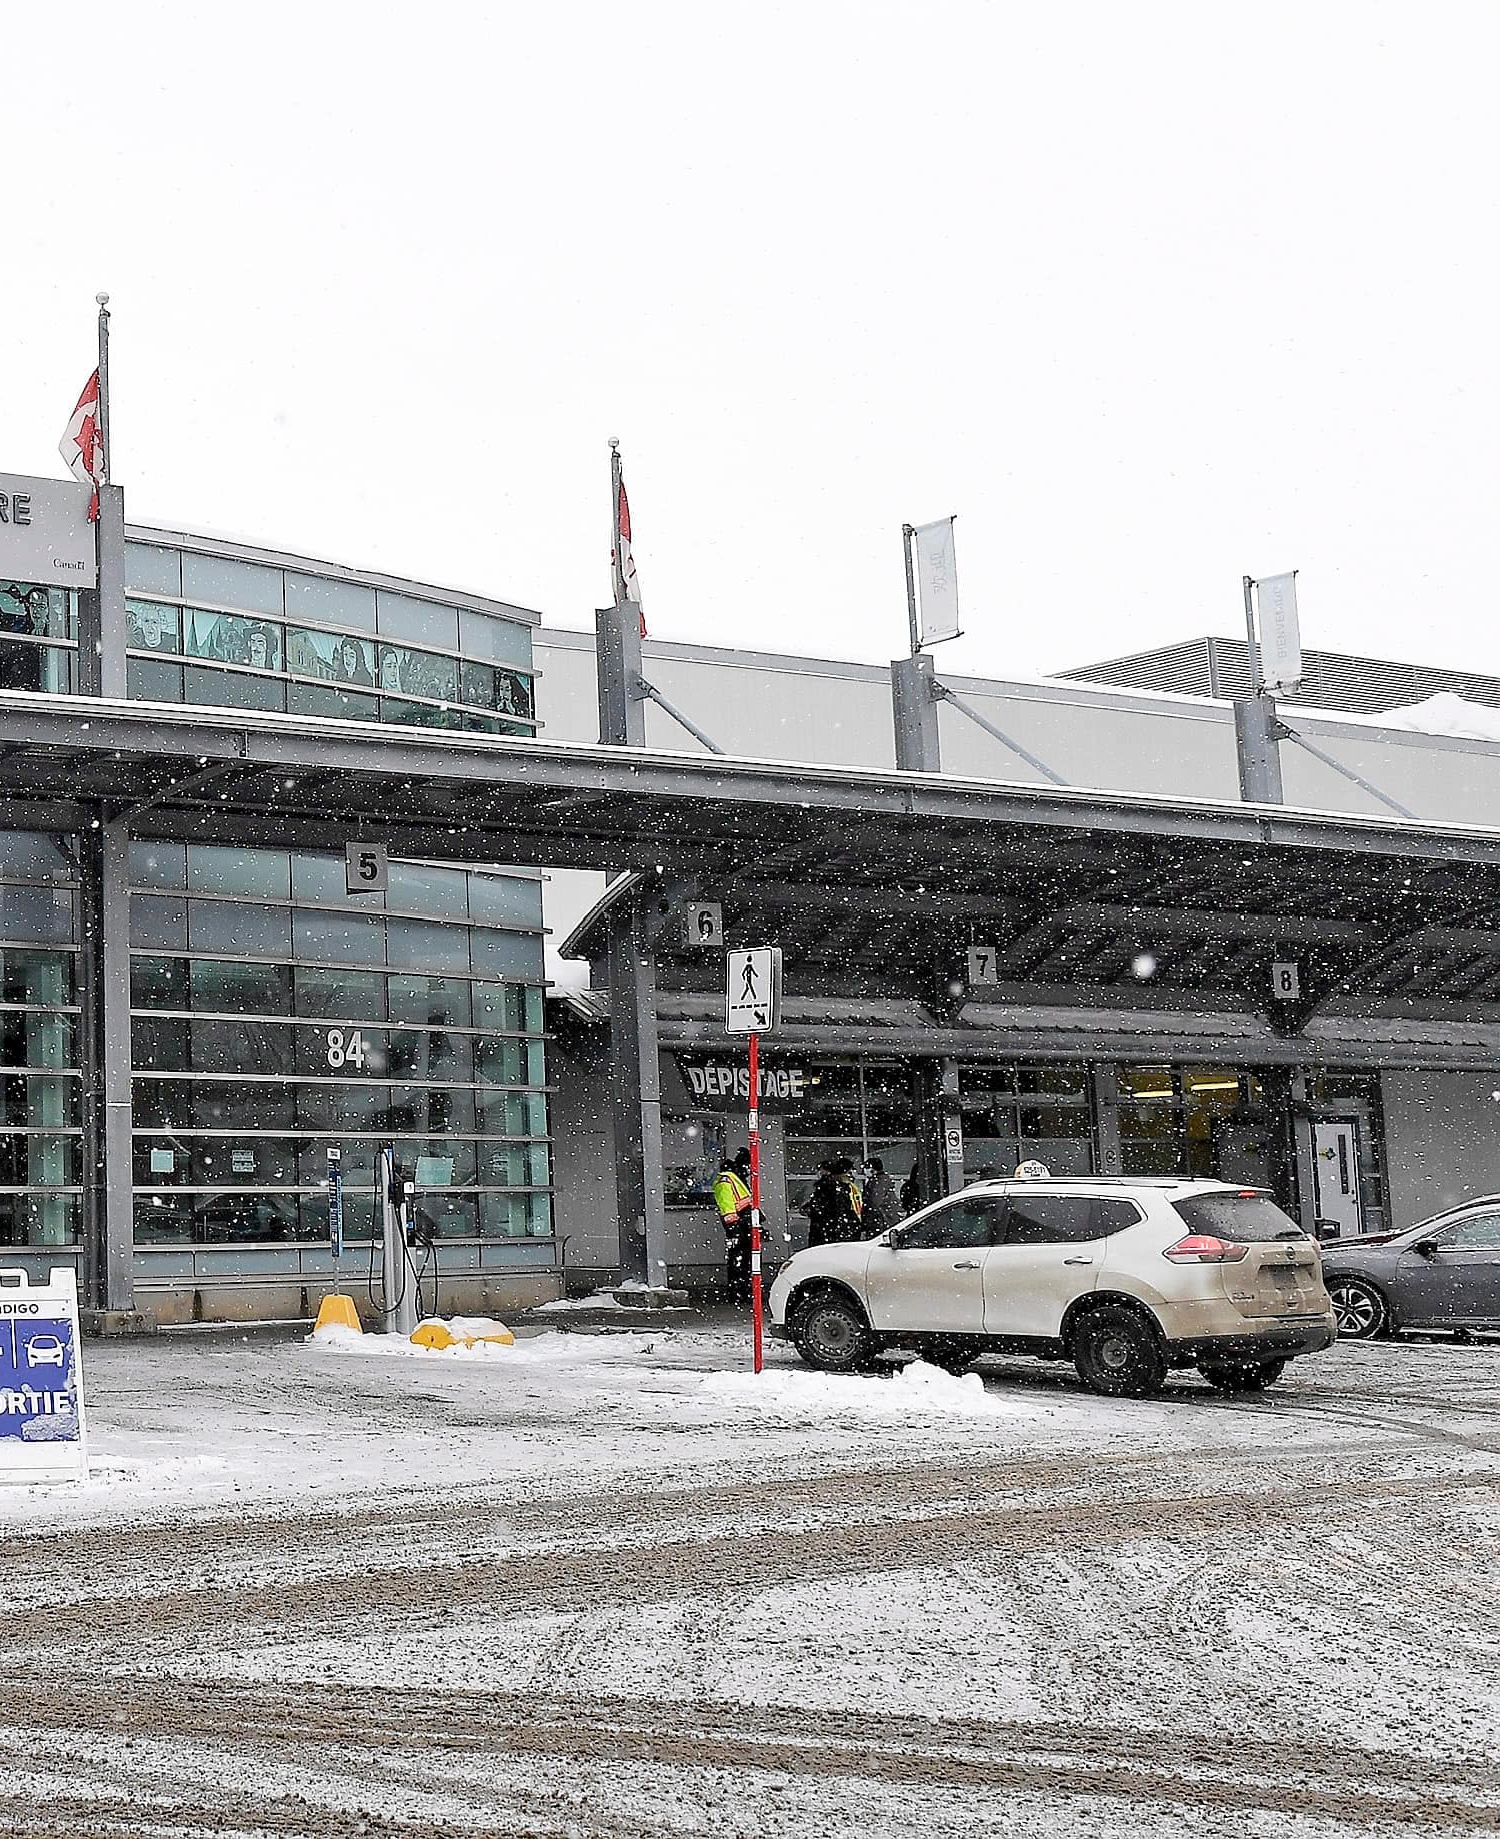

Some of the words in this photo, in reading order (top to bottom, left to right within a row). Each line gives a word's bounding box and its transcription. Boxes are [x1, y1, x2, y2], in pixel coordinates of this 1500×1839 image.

[359, 852, 378, 881] 5
[698, 910, 714, 941] 6
[975, 953, 989, 977] 7
[1280, 970, 1292, 992] 8
[327, 1029, 365, 1069] 84
